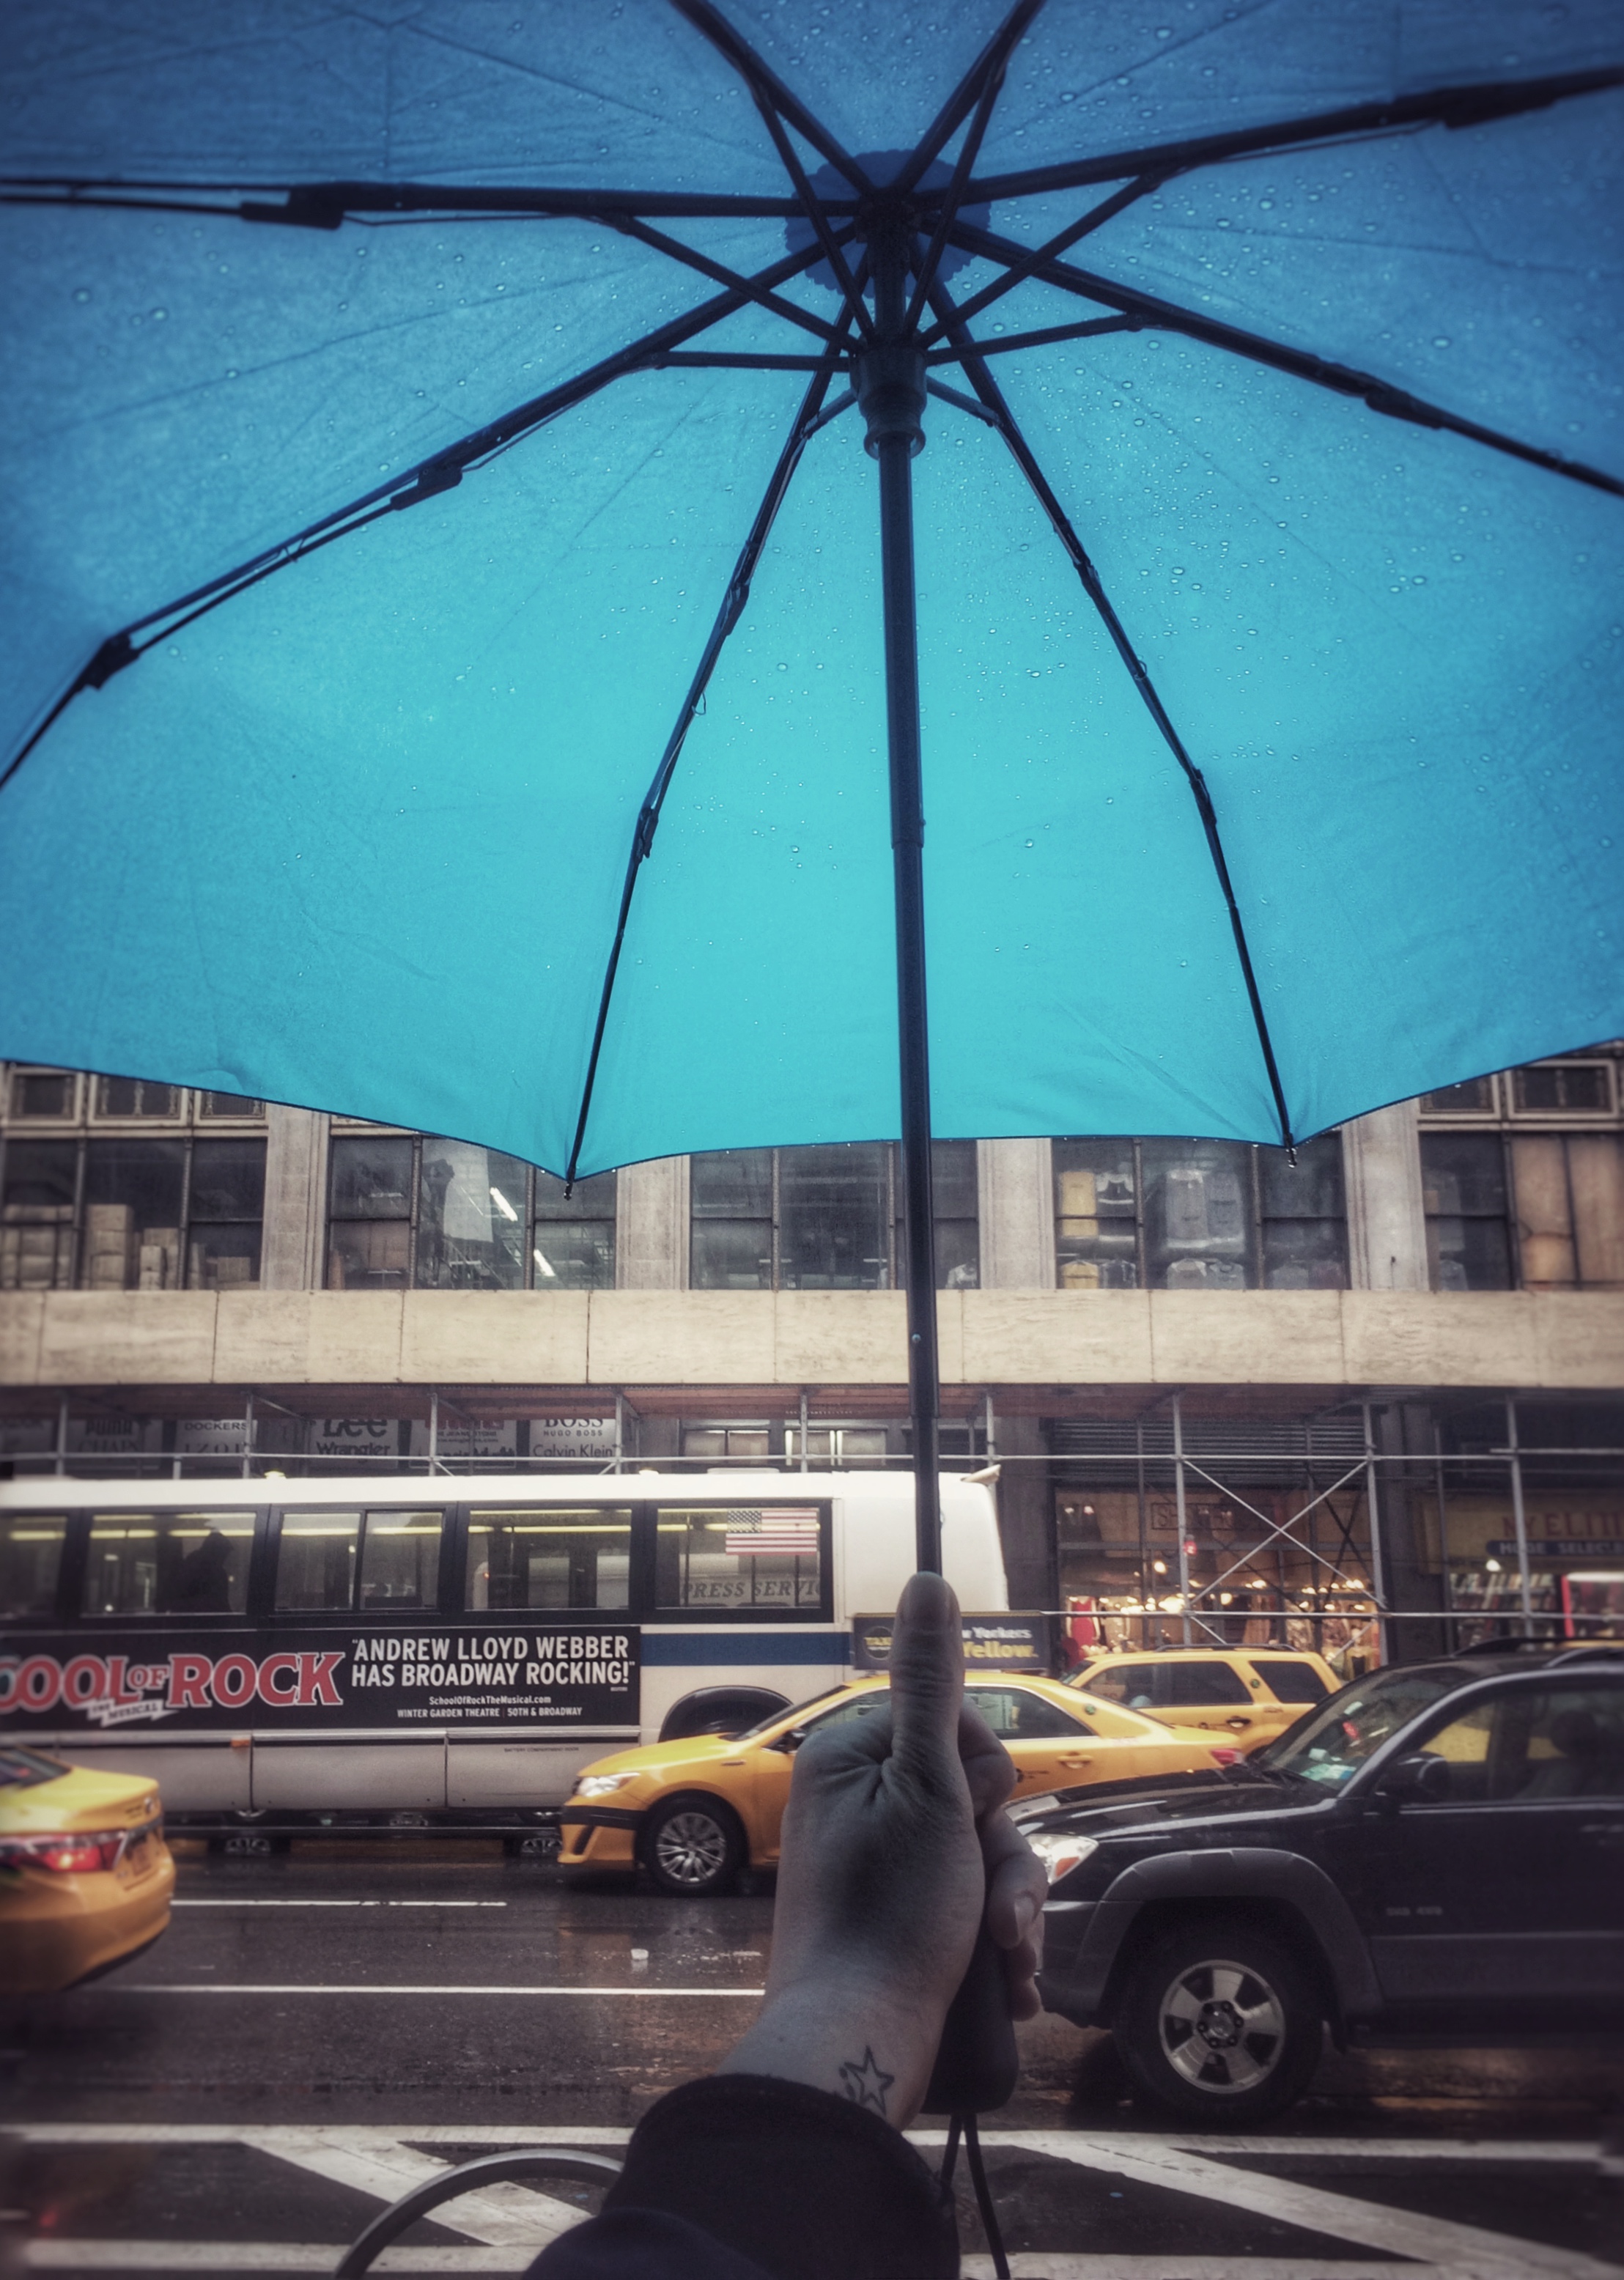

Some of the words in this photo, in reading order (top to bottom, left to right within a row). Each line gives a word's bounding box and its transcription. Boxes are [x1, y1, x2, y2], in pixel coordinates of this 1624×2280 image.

[185, 1421, 249, 1431] DOCKERS
[322, 1419, 388, 1438] Lee
[316, 1441, 391, 1464] Wrangler
[533, 1443, 576, 1458] Calvin
[580, 1442, 613, 1458] Klein
[457, 1637, 528, 1661] LLOYD
[536, 1635, 629, 1659] WEBBER
[127, 1664, 171, 1690] OF
[166, 1651, 346, 1708] ROCK
[352, 1663, 395, 1687] HAS
[402, 1662, 520, 1686] BROADWAY
[429, 1694, 552, 1706] SchoolOfRockTheMusical.com
[397, 1708, 429, 1719] WINTER
[429, 1708, 463, 1719] GARDEN
[465, 1708, 501, 1718] THEATRE
[507, 1707, 529, 1717] 50TH
[530, 1707, 537, 1717] &
[539, 1706, 583, 1716] BROADWAY
